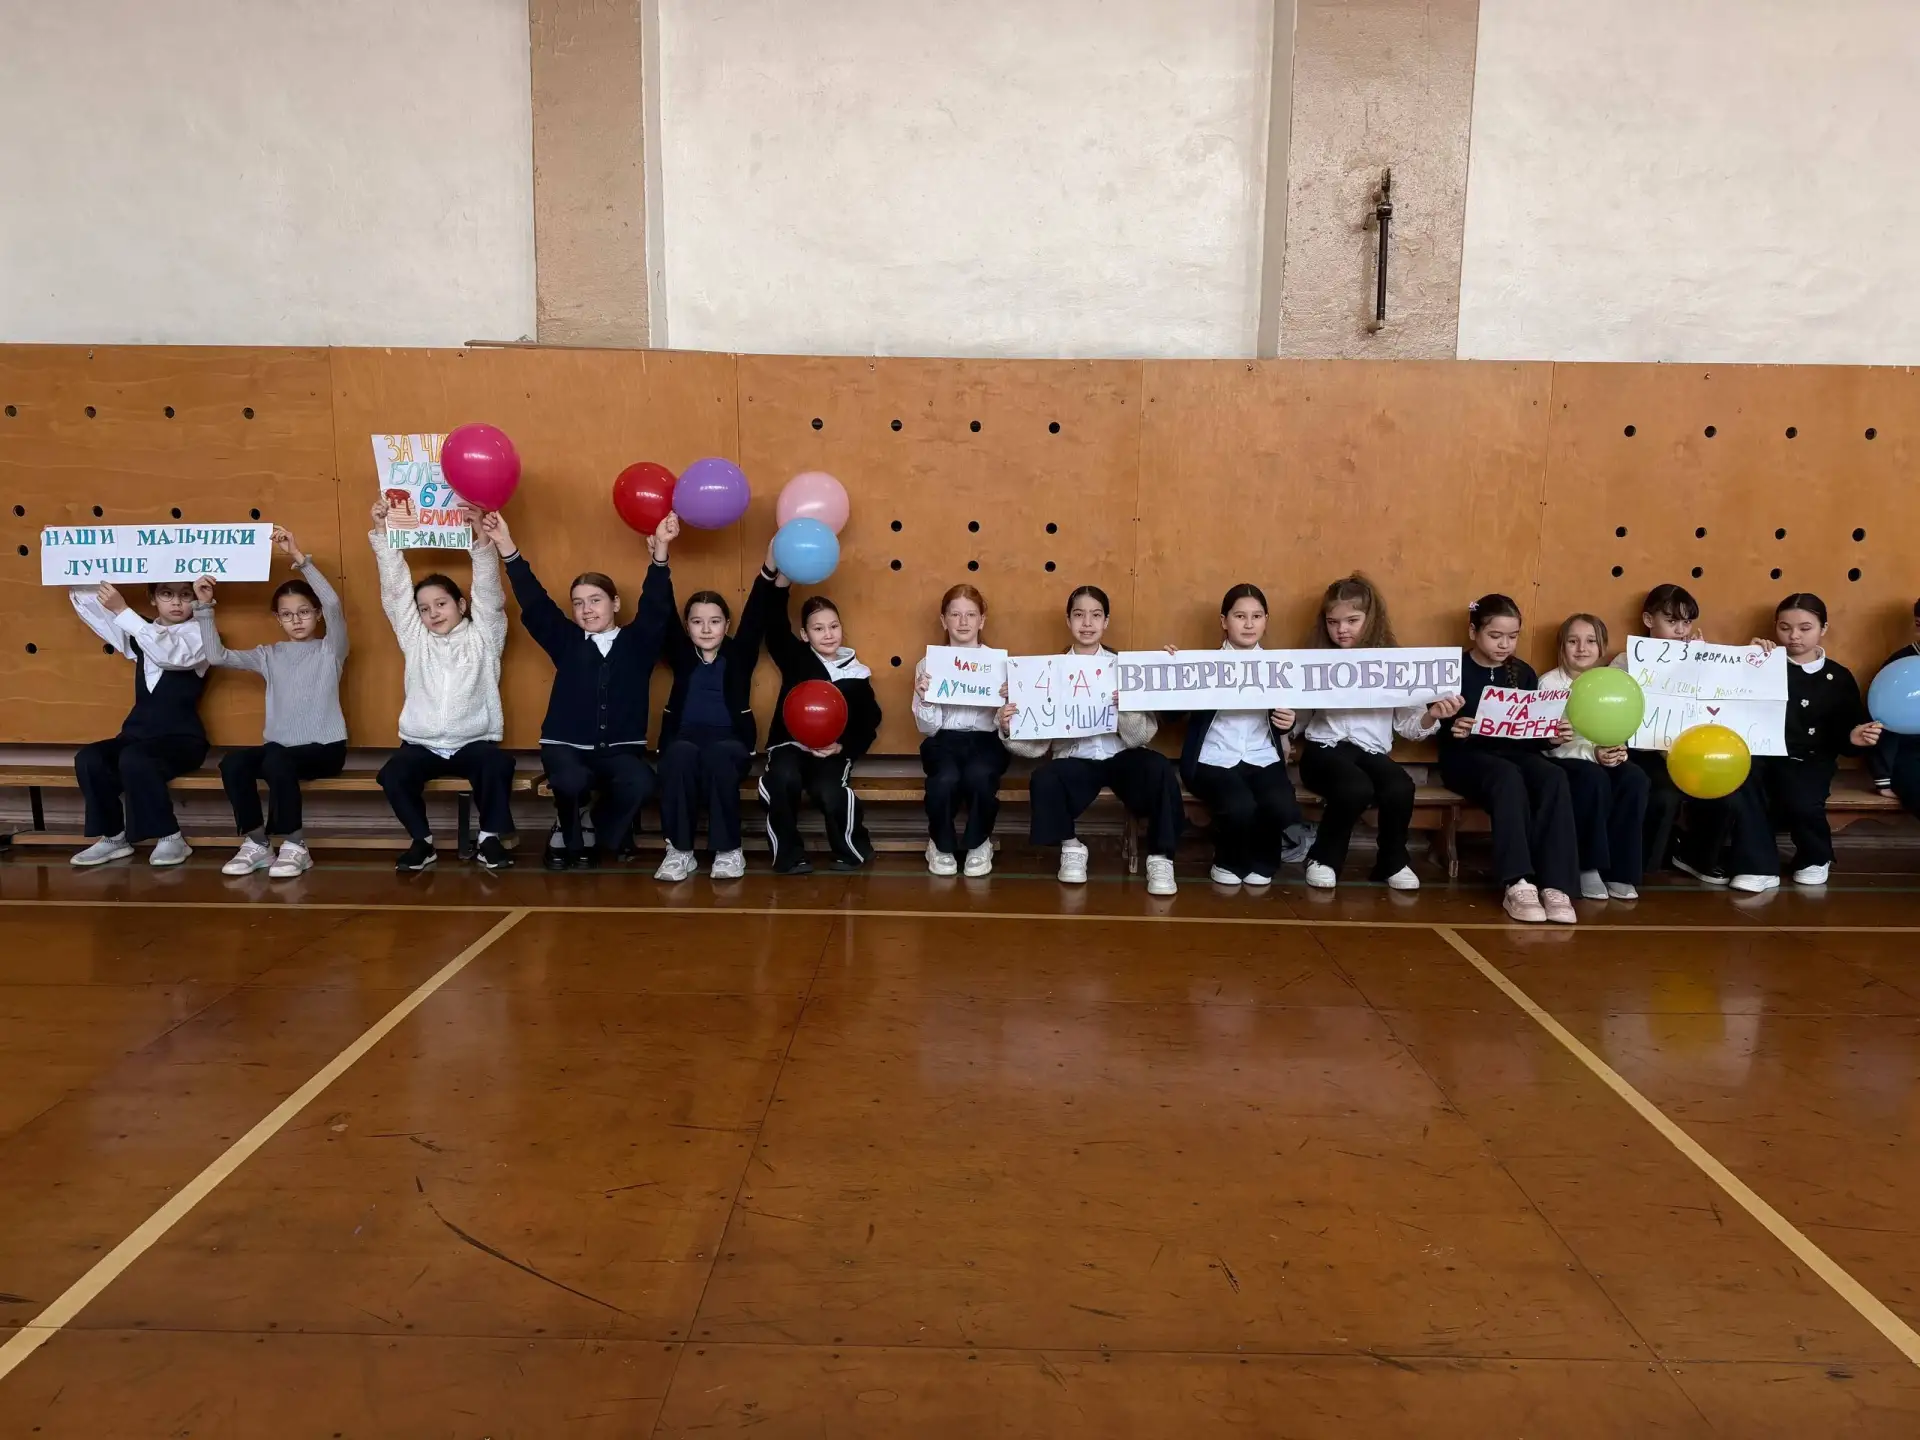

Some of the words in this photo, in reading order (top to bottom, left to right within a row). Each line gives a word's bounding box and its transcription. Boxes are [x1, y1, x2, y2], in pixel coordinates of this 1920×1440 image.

[384, 435, 414, 462] ЗА
[389, 462, 447, 486] БОЛЕ
[420, 508, 471, 527] БЛИНО
[45, 529, 115, 546] НАШИ
[137, 528, 256, 546] МАЛЬЧИКИ
[390, 531, 410, 549] НЕ
[64, 557, 148, 576] ЛУЧШЕ
[174, 557, 228, 574] ВСЕХ
[1119, 660, 1266, 694] ВПЕРЕД
[1301, 658, 1461, 696] ПОБЕДЕ
[937, 678, 991, 698] ЛУЧШИЕ
[1483, 688, 1571, 704] МАЛЬЧИКИ
[1020, 704, 1115, 729] ЛУЧШИЕ
